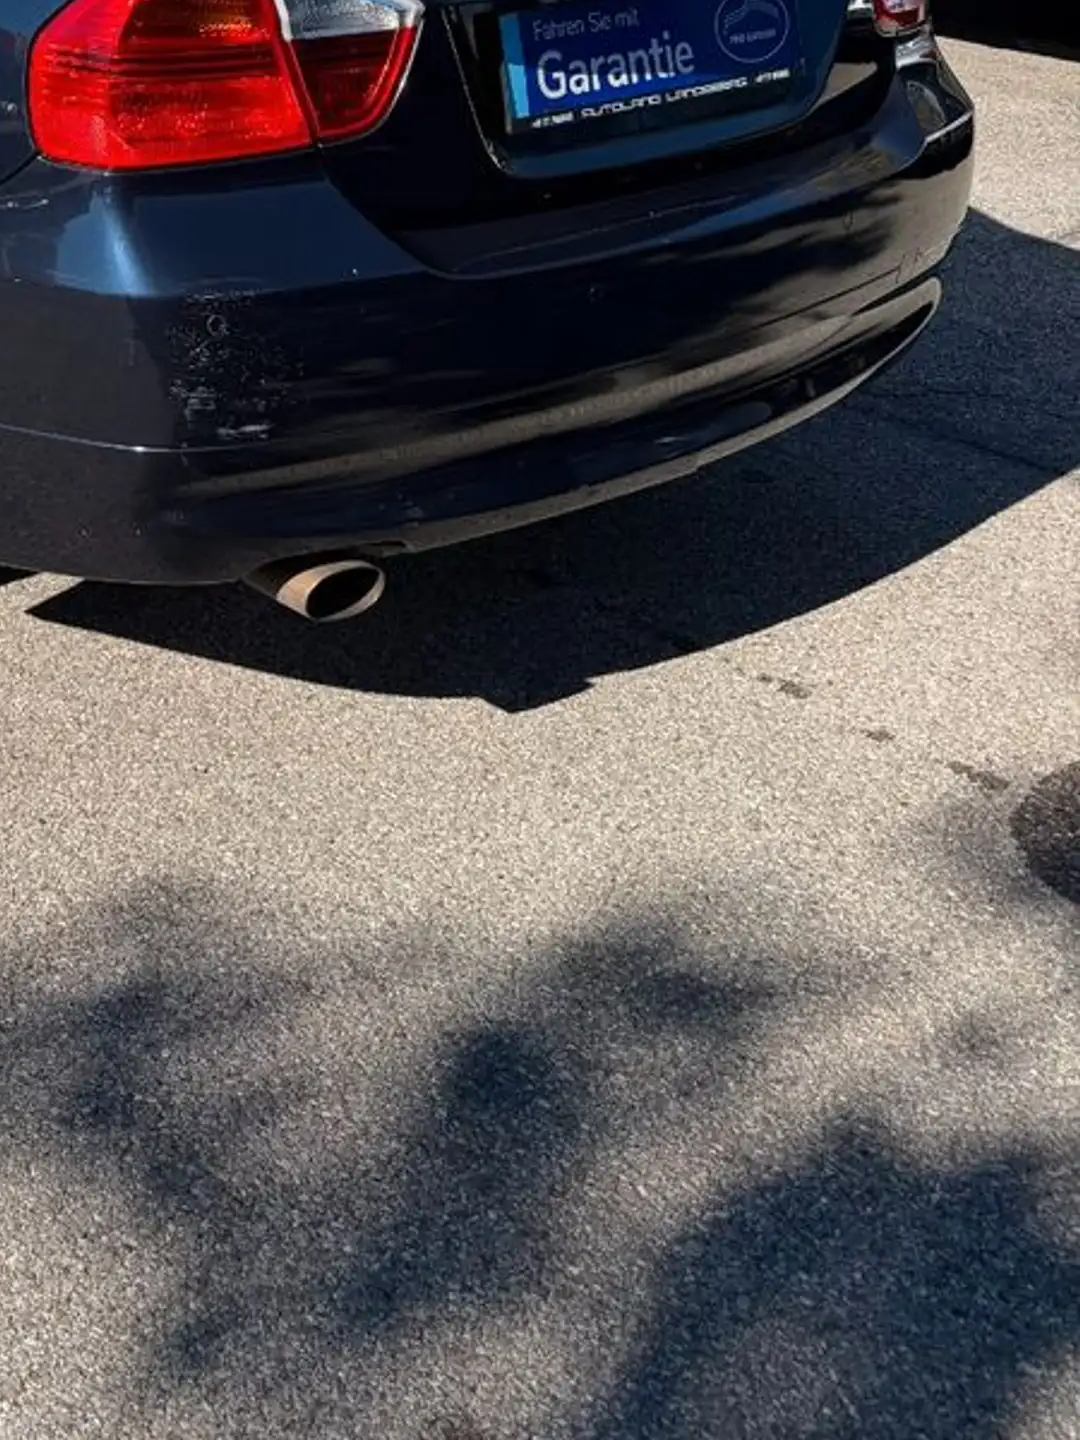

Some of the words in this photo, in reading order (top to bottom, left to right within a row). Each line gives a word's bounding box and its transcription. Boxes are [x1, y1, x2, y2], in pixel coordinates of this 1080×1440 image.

[532, 18, 585, 42] Fahren
[587, 10, 612, 33] Sie
[614, 7, 640, 28] mit
[537, 30, 695, 99] Garantie
